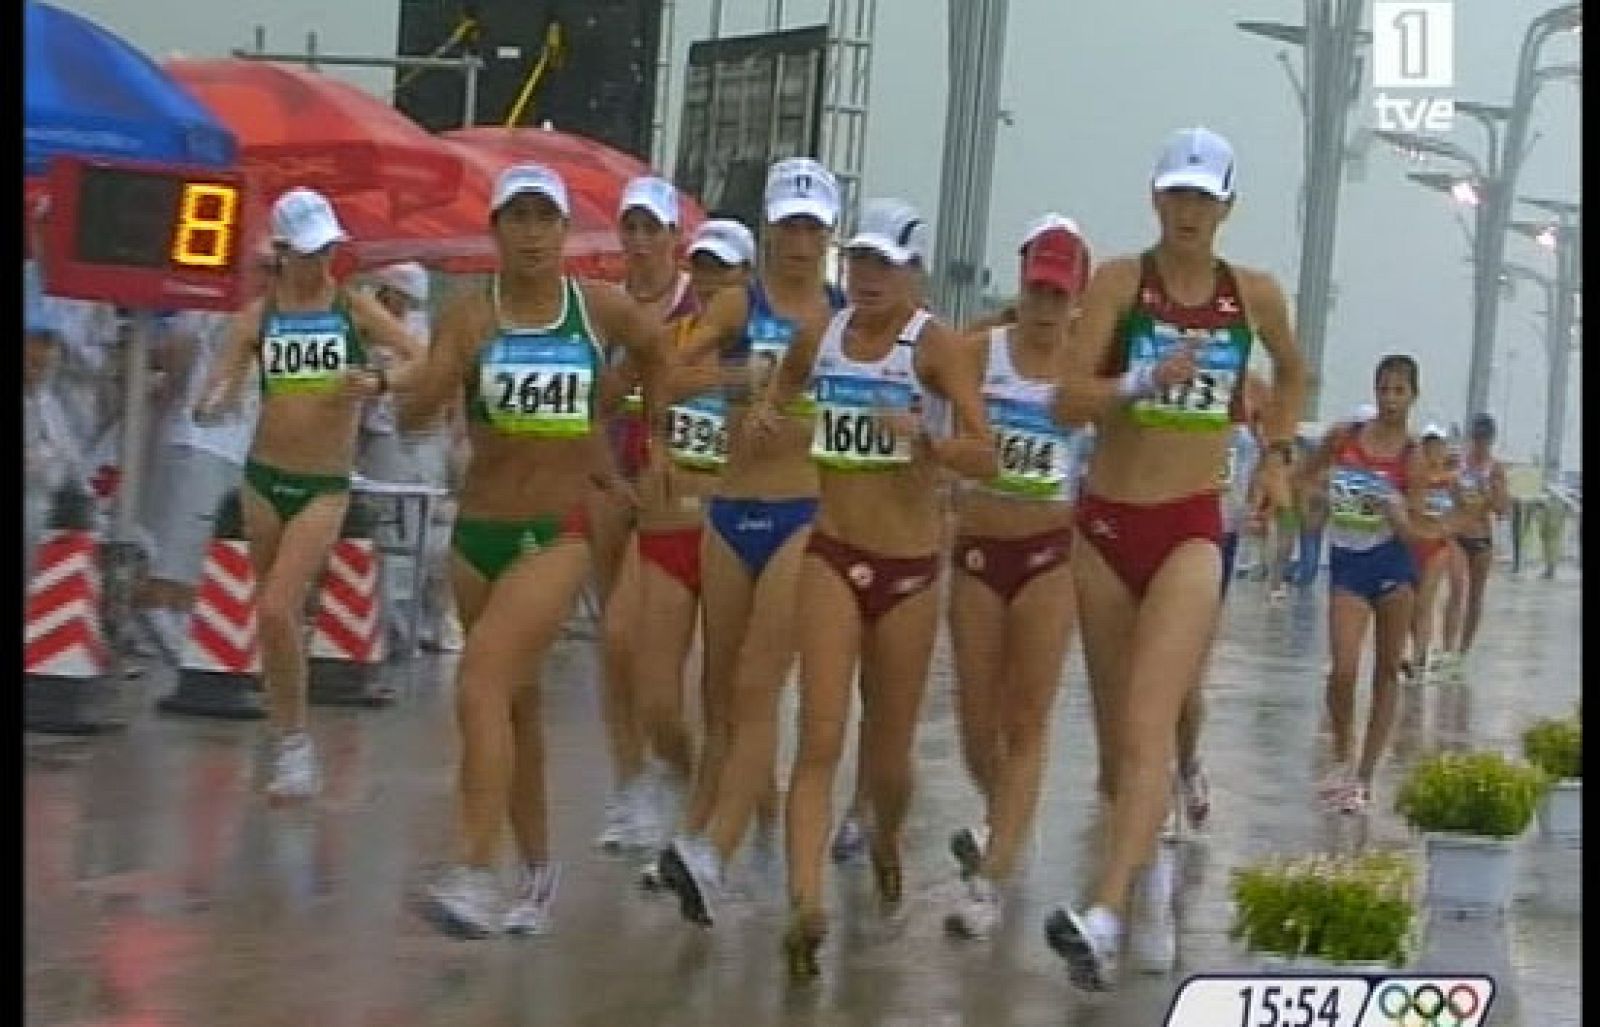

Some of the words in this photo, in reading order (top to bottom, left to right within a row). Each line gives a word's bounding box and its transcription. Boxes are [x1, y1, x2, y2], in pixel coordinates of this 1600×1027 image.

[172, 183, 238, 266] 8
[269, 338, 339, 374] 2046
[494, 371, 579, 414] 2641
